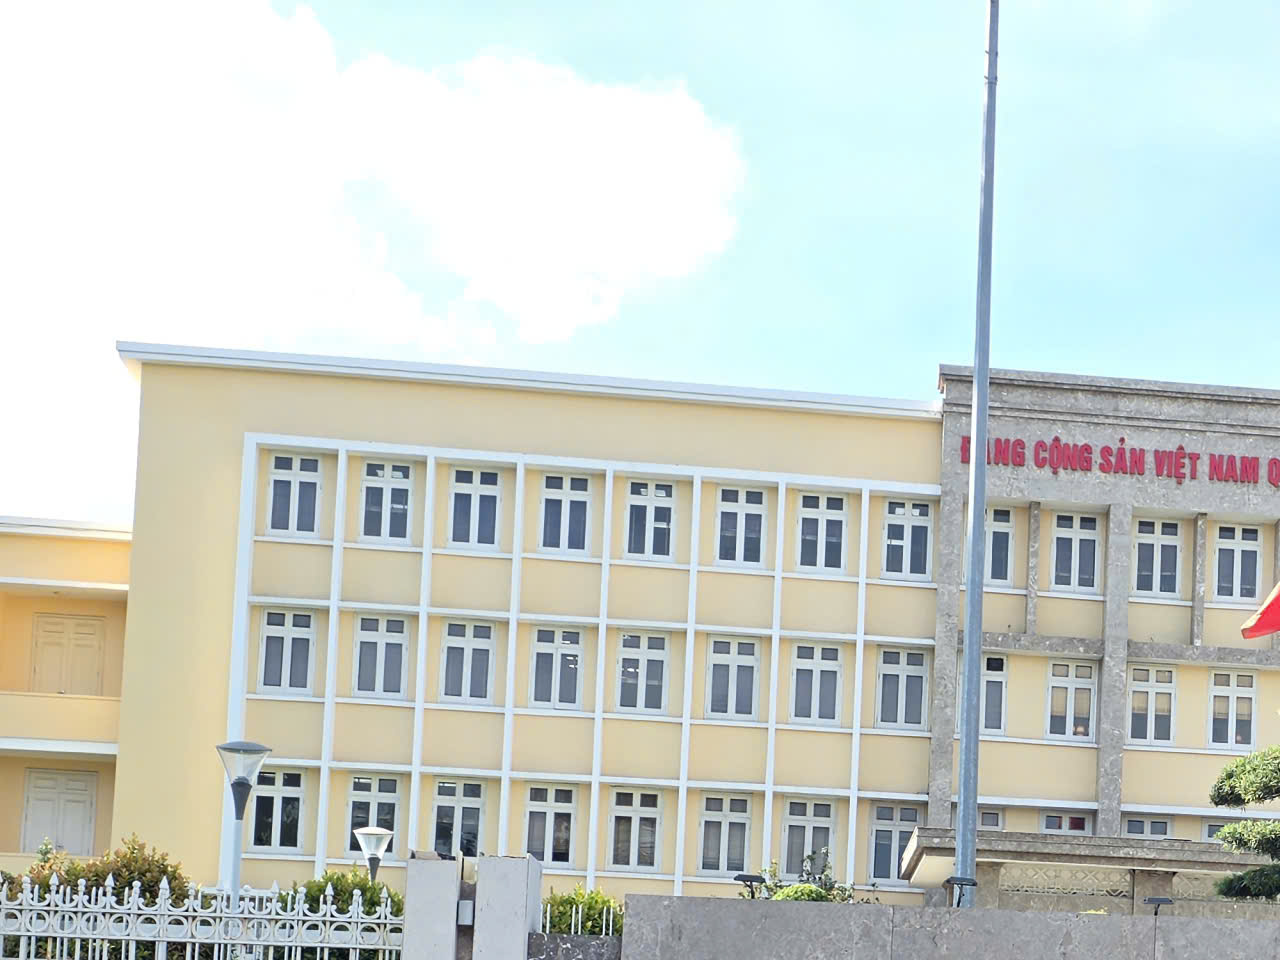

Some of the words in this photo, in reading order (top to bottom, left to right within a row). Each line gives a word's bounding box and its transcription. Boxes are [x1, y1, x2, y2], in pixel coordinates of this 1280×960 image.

[961, 434, 1026, 467] ĐNG
[1033, 434, 1093, 476] CỘNG
[1099, 436, 1146, 476] SẢN
[1153, 443, 1201, 485] VIỆT
[1208, 452, 1260, 484] NAM
